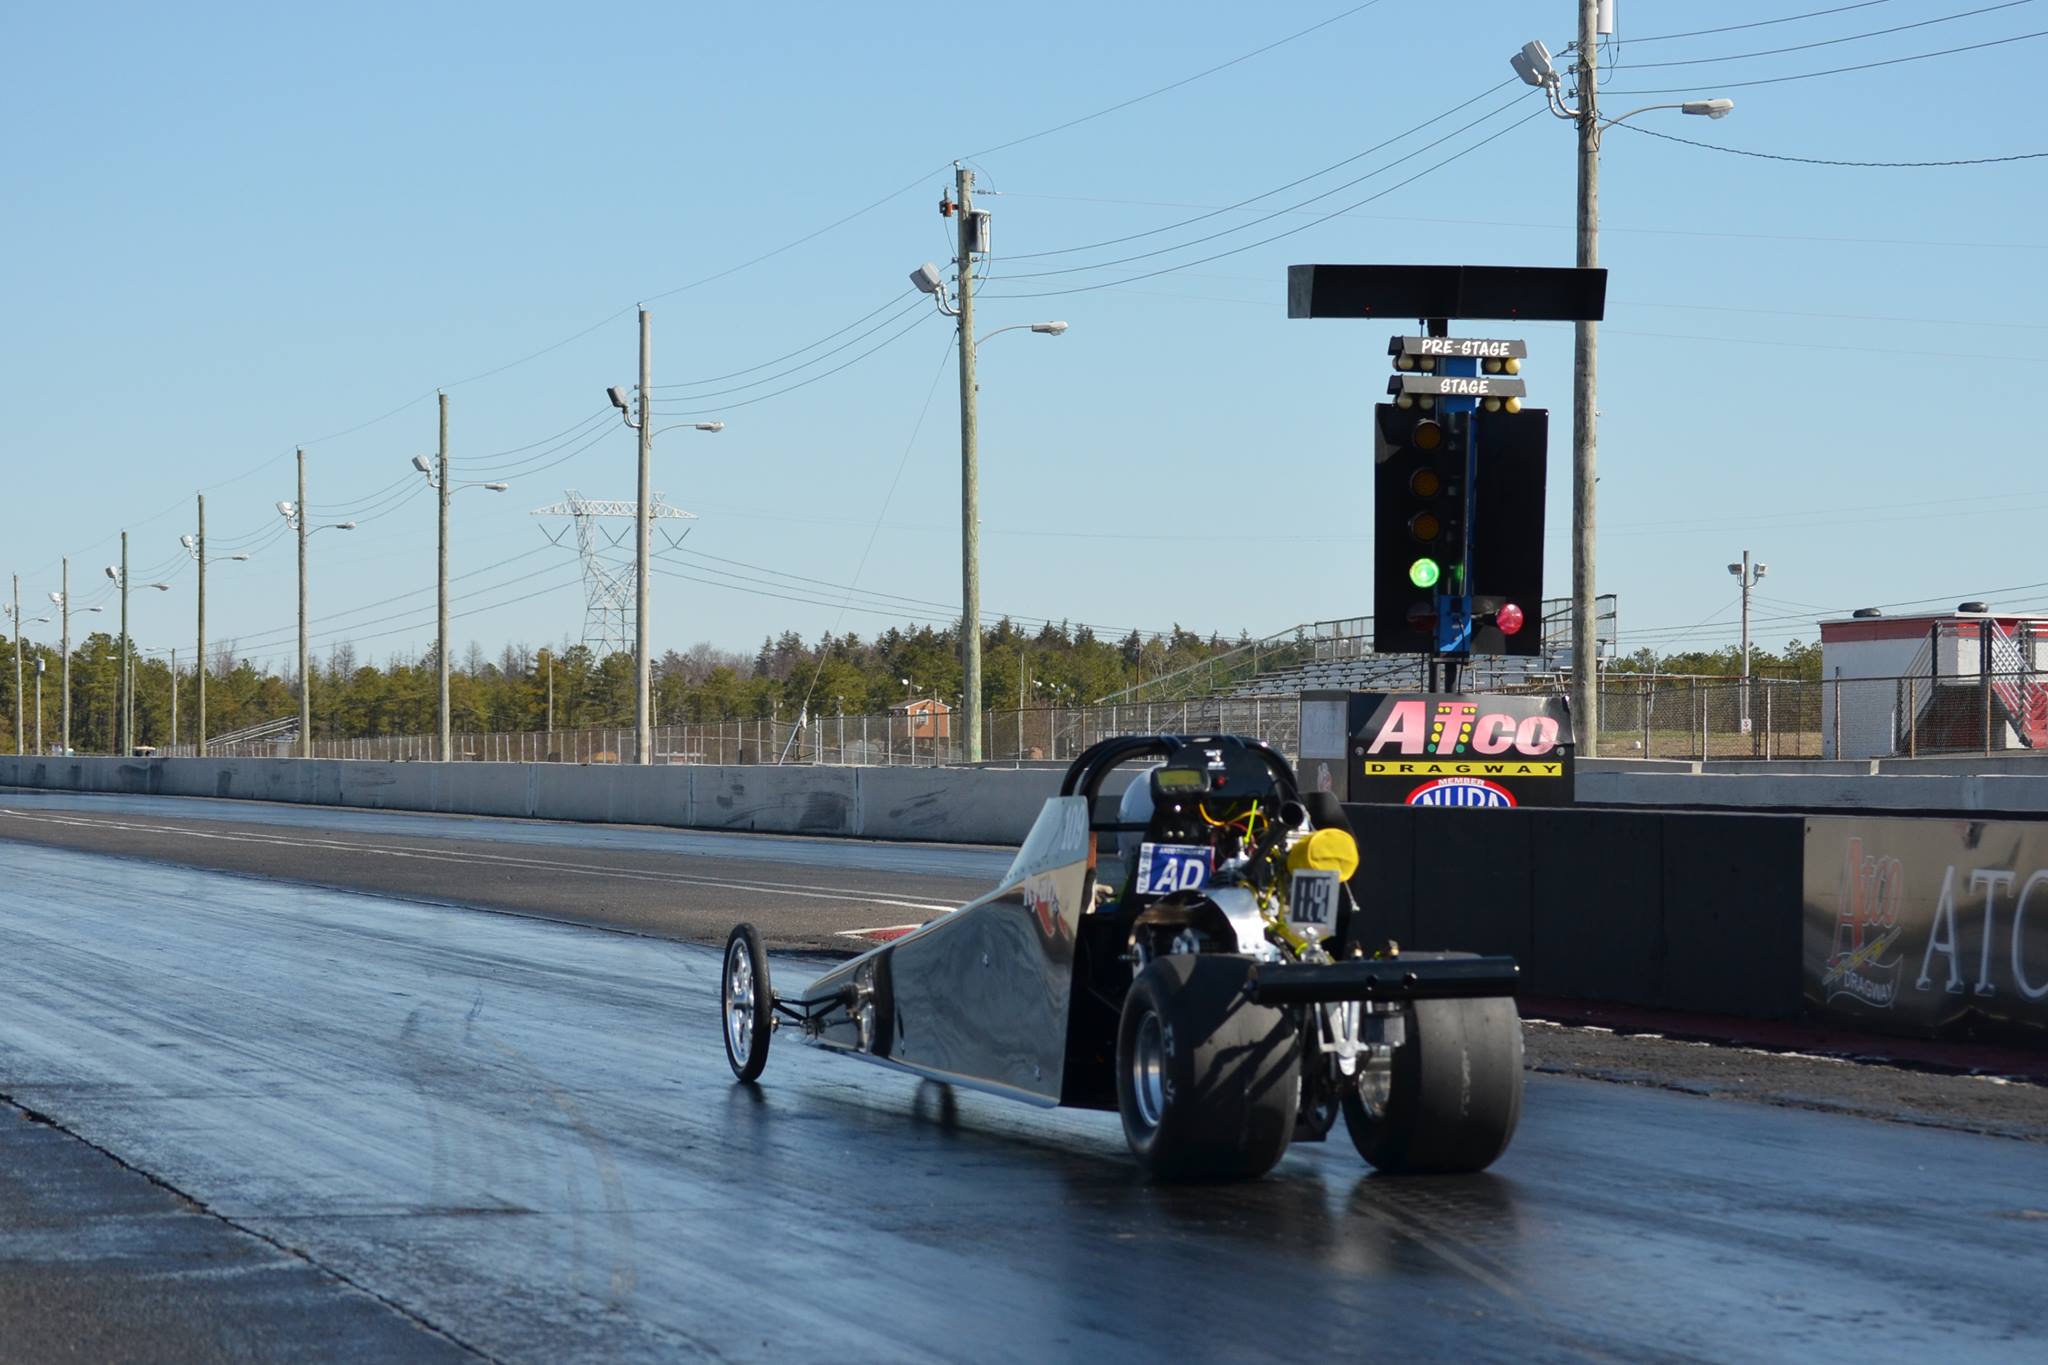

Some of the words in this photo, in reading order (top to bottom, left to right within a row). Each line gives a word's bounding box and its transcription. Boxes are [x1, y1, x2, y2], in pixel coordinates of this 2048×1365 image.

[1421, 338, 1511, 357] PRE-STAGE
[1440, 378, 1489, 395] STAGE
[1371, 763, 1560, 774] DRAGWAY
[1437, 777, 1486, 786] MEMBER
[1153, 858, 1205, 892] AD
[1843, 969, 1895, 1001] DRAGWAY
